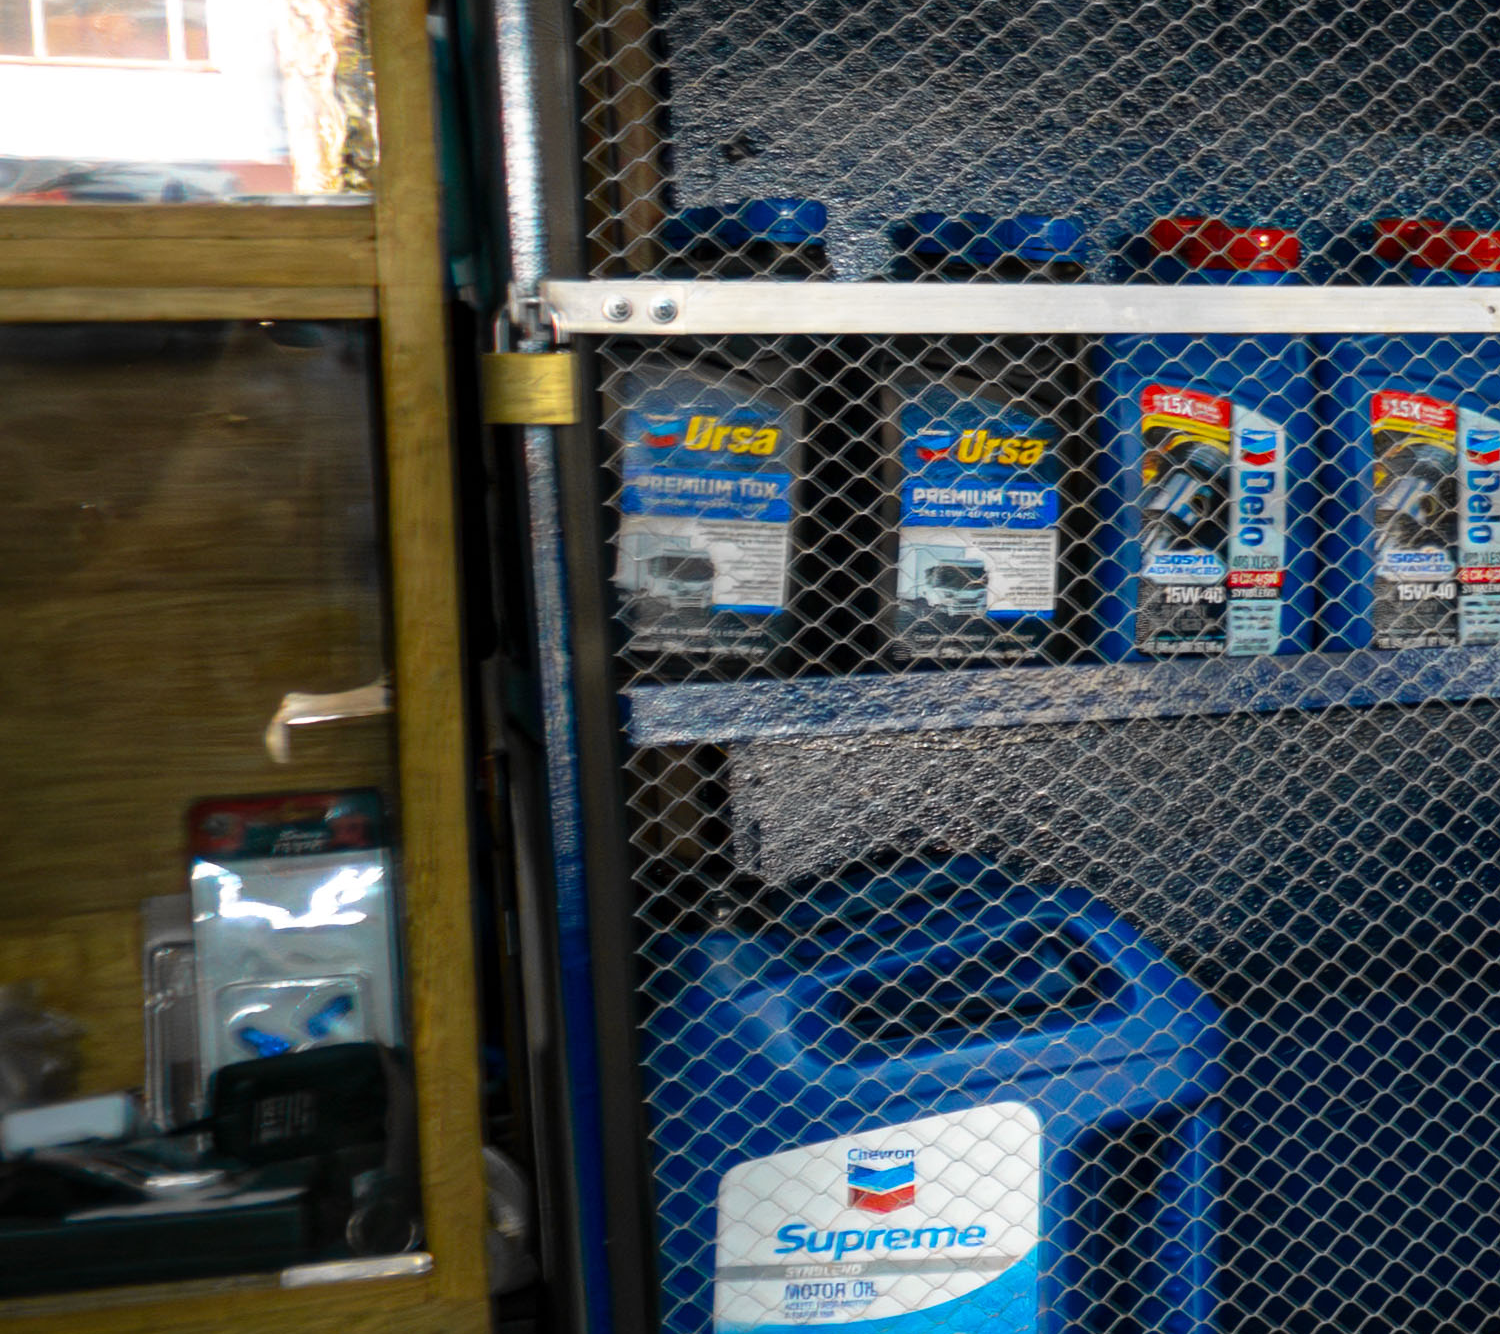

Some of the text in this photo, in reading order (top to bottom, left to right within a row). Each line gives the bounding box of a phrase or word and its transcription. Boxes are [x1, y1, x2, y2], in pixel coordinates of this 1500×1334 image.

[685, 416, 784, 456] Ursa
[957, 428, 1049, 466] Ursa
[638, 476, 733, 499] PREMIUM
[912, 487, 1003, 506] PREMIUM
[1239, 470, 1277, 547] Delo
[1164, 584, 1225, 605] 15W-40
[1398, 582, 1455, 602] 15W-40
[847, 1147, 916, 1162] Chevron
[774, 1222, 988, 1261] Supreme
[784, 1281, 879, 1301] MOTOR OIL
